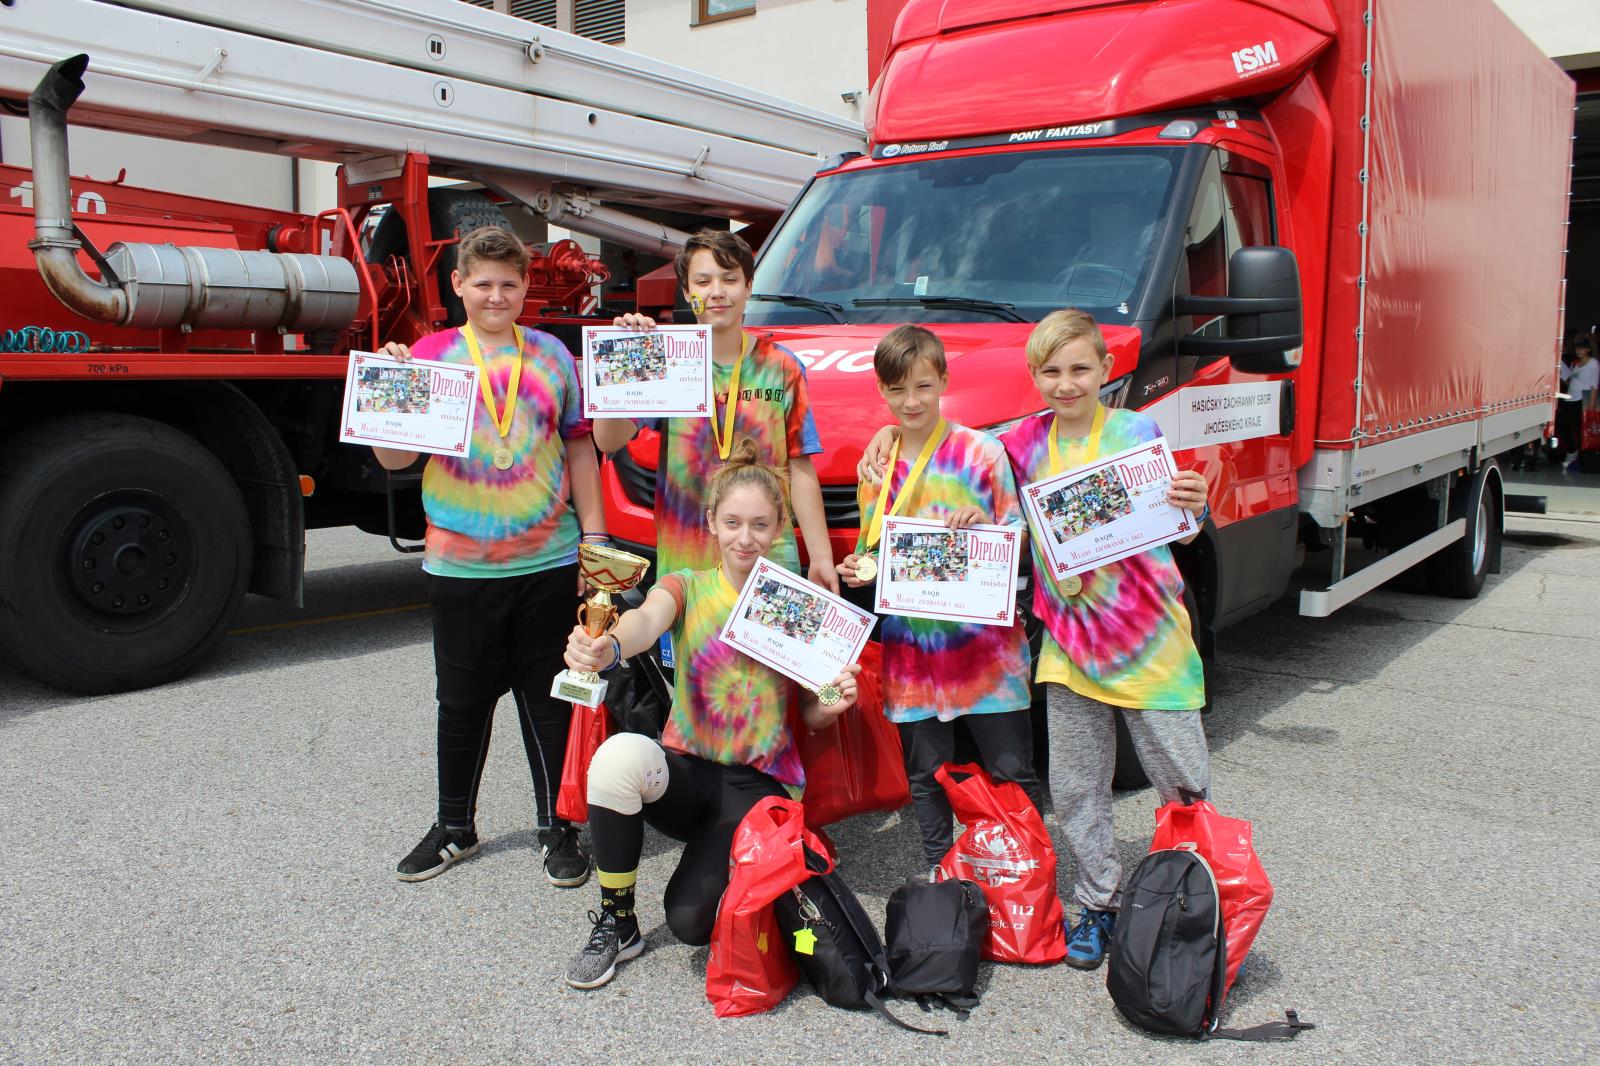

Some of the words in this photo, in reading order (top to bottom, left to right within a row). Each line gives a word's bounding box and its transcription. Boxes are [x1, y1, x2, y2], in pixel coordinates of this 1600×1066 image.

[1231, 40, 1279, 74] ISM
[1009, 130, 1042, 143] PONY
[1045, 123, 1102, 138] FANTASY
[667, 335, 704, 359] DIPLOM
[431, 371, 470, 399] DIPLOM
[1191, 395, 1222, 413] HASIČSKÝ
[1223, 392, 1256, 409] ZÁCHRANNÝ
[1256, 393, 1272, 406] SBOR
[1203, 418, 1243, 435] JIHOČESKÉHO
[1244, 415, 1262, 428] KRAJE
[1118, 457, 1168, 490] DIPLOM
[969, 534, 1011, 563] DIPLOM
[823, 606, 863, 643] DIPLOM
[1012, 904, 1034, 916] 112
